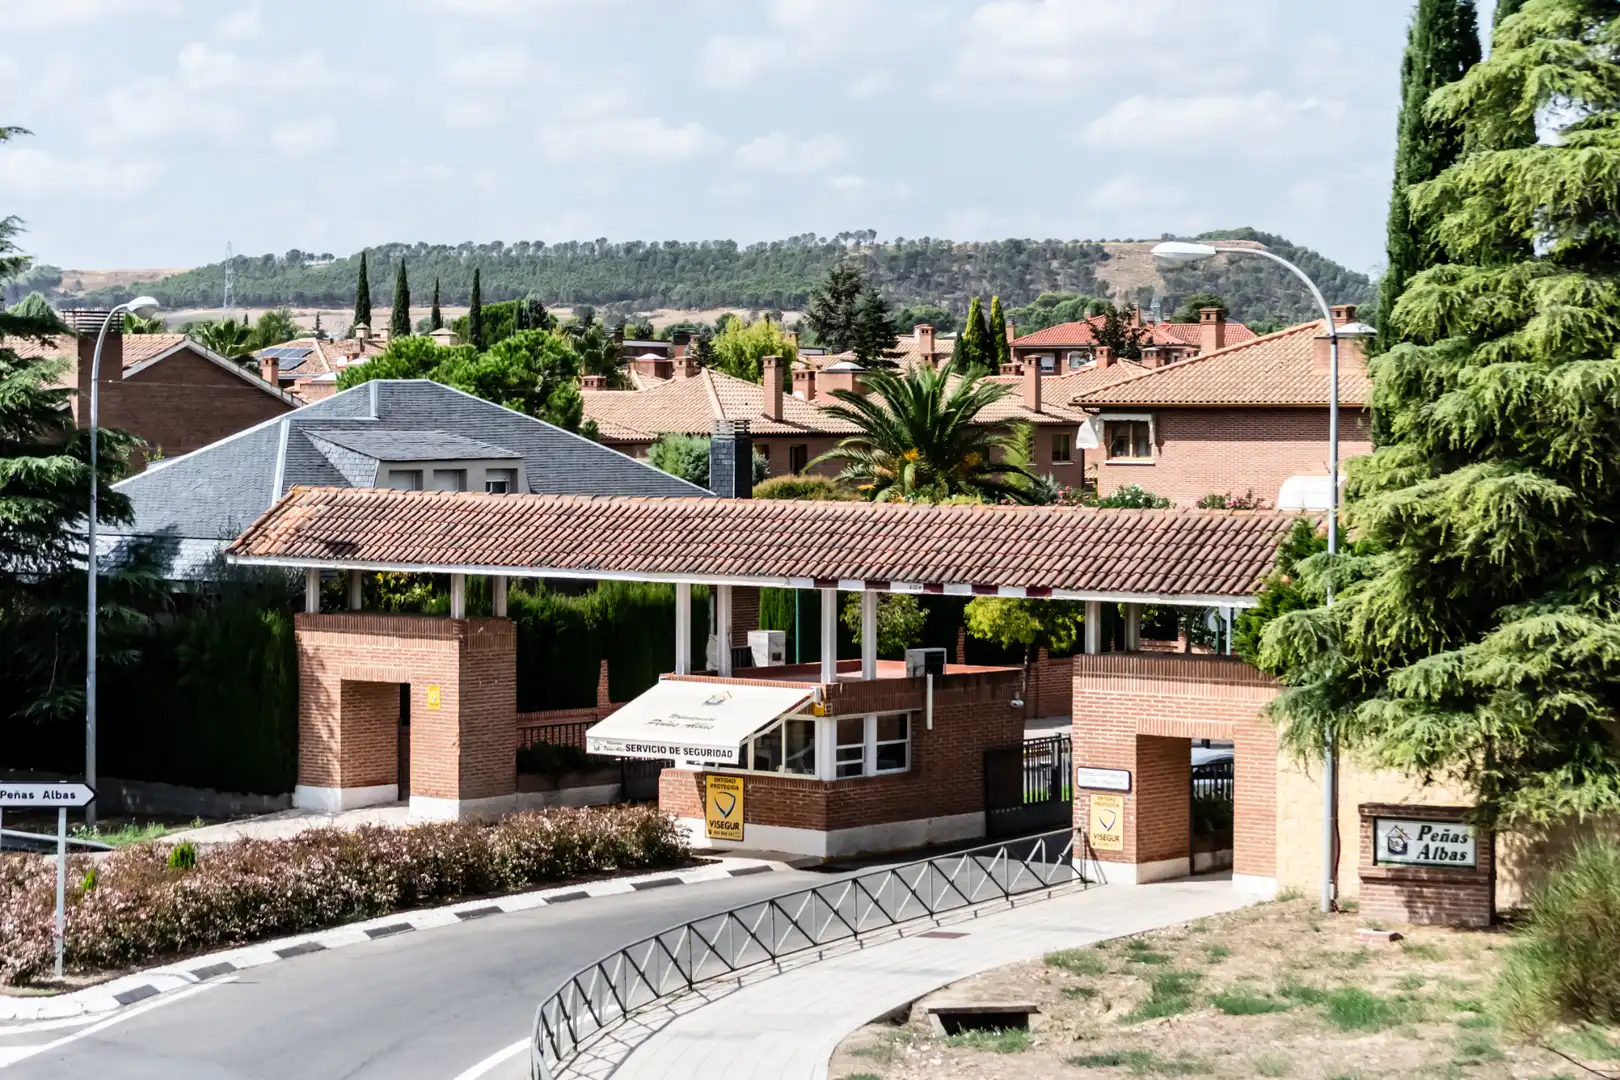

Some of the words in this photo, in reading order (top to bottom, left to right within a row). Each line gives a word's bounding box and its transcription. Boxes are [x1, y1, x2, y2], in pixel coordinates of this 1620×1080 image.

[625, 743, 667, 754] SERVICIO
[669, 746, 680, 755] DE
[683, 747, 733, 759] SEGURIDAD
[710, 783, 740, 791] PROTEGIDA
[0, 789, 35, 799] Peñas
[43, 790, 76, 800] Albas
[709, 820, 740, 831] VISEGUR
[1093, 832, 1121, 842] VISEGUR
[1416, 824, 1470, 844] Peñas
[1416, 843, 1468, 862] Albas
